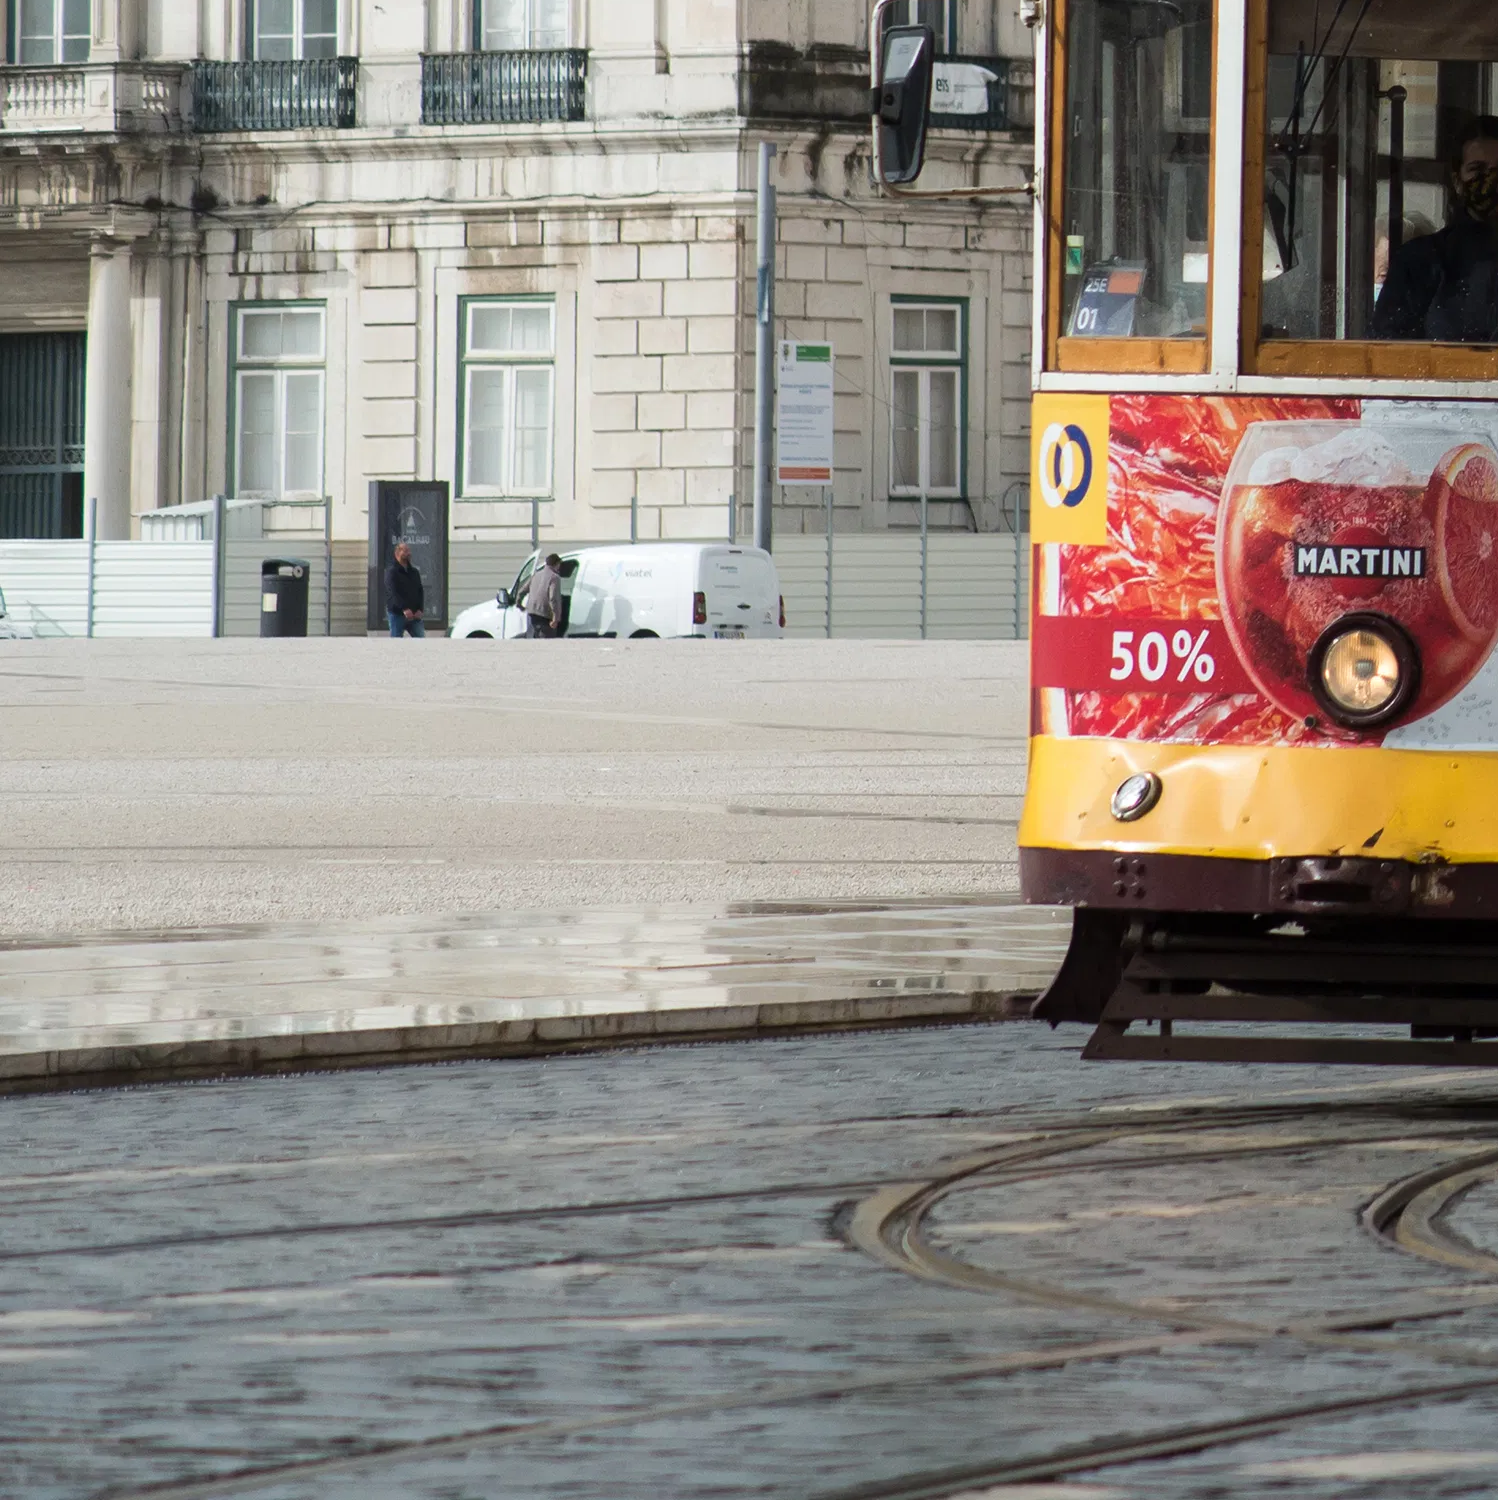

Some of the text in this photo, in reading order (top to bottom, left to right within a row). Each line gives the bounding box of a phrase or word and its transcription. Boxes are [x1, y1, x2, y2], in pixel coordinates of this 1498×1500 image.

[1084, 278, 1108, 292] 25E
[1077, 307, 1099, 330] 01
[1297, 547, 1422, 576] MARTINI
[1109, 629, 1215, 682] 50%
